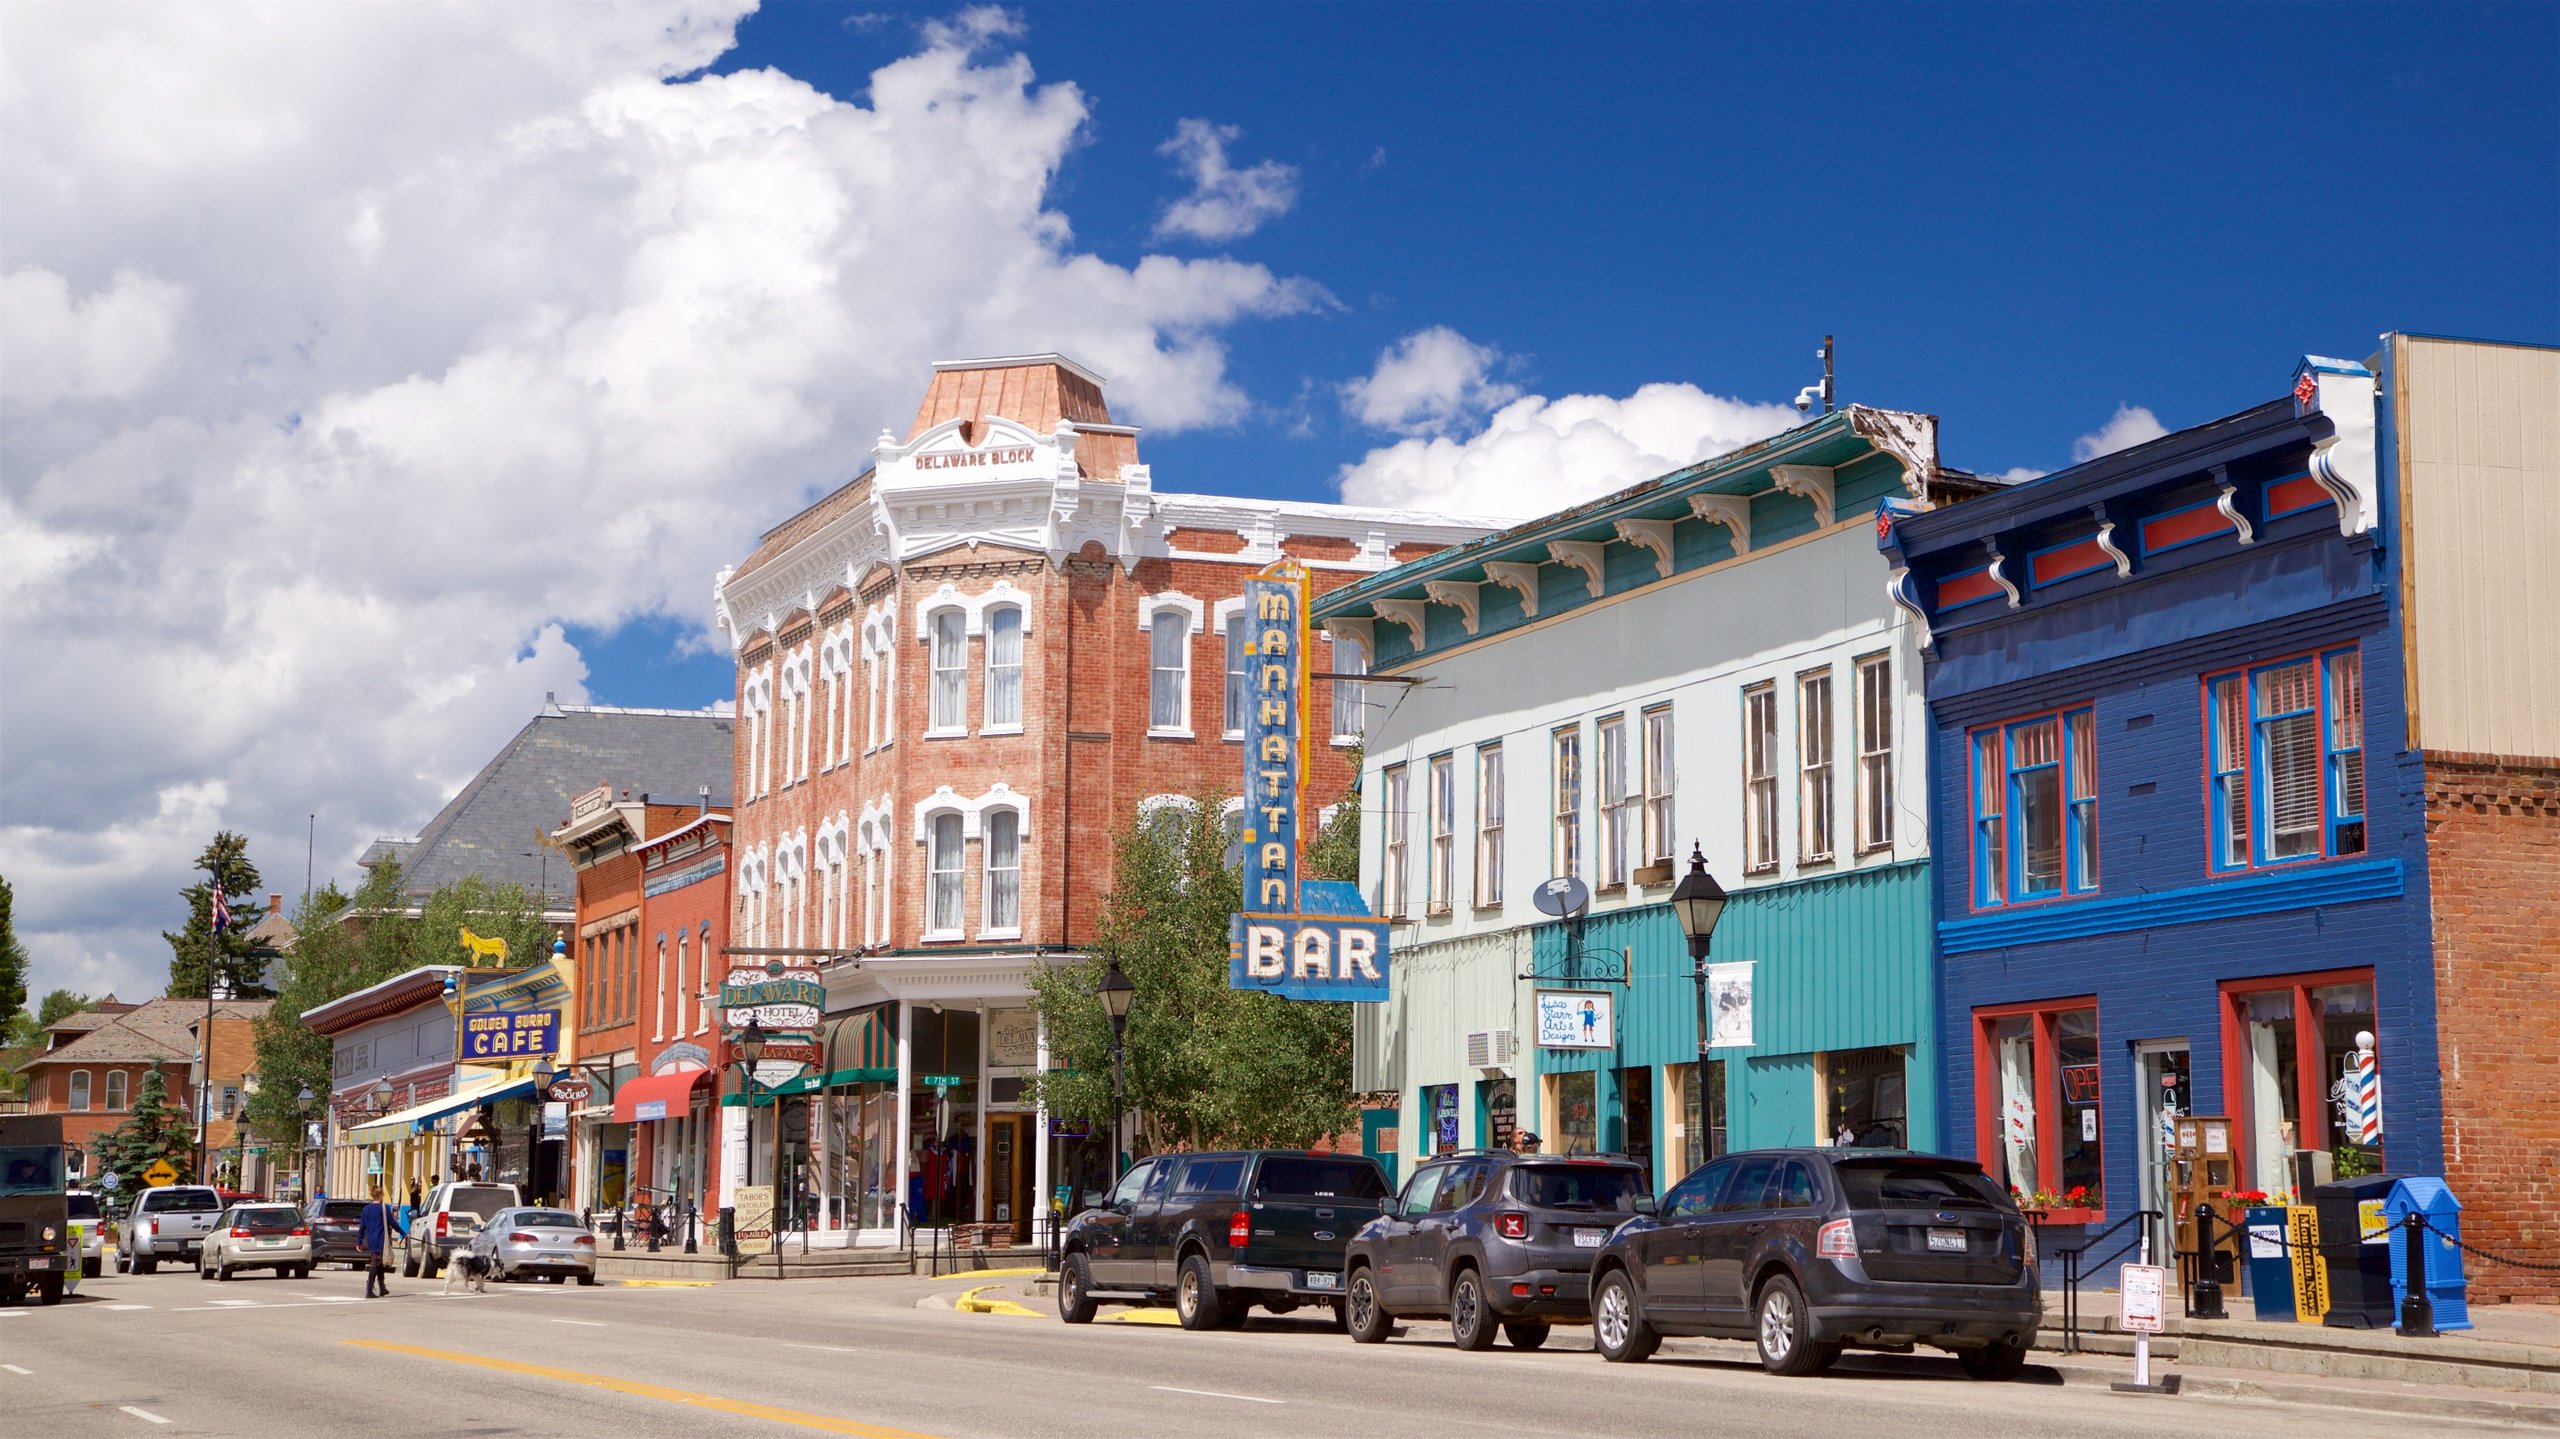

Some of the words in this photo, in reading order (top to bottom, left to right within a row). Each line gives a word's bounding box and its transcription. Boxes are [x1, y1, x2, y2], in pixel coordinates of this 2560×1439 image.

[916, 453, 987, 470] DELAWARE
[992, 448, 1035, 465] BLOCK
[1258, 591, 1291, 905] MANHATTAN
[1248, 924, 1381, 979] BAR
[724, 981, 821, 1006] DELAWARE
[1541, 994, 1567, 1009] Lisa
[469, 1016, 508, 1031] GOLDEN
[515, 1013, 551, 1028] BURRO
[763, 1007, 802, 1017] HOTEL
[1544, 1019, 1566, 1030] Art
[1568, 1022, 1574, 1030] &
[474, 1030, 543, 1054] CAFE
[1543, 1029, 1575, 1043] Design
[554, 1088, 576, 1099] ROCK
[2065, 1067, 2099, 1100] OPE
[740, 1193, 769, 1202] TABOR'S
[2306, 1280, 2317, 1315] News
